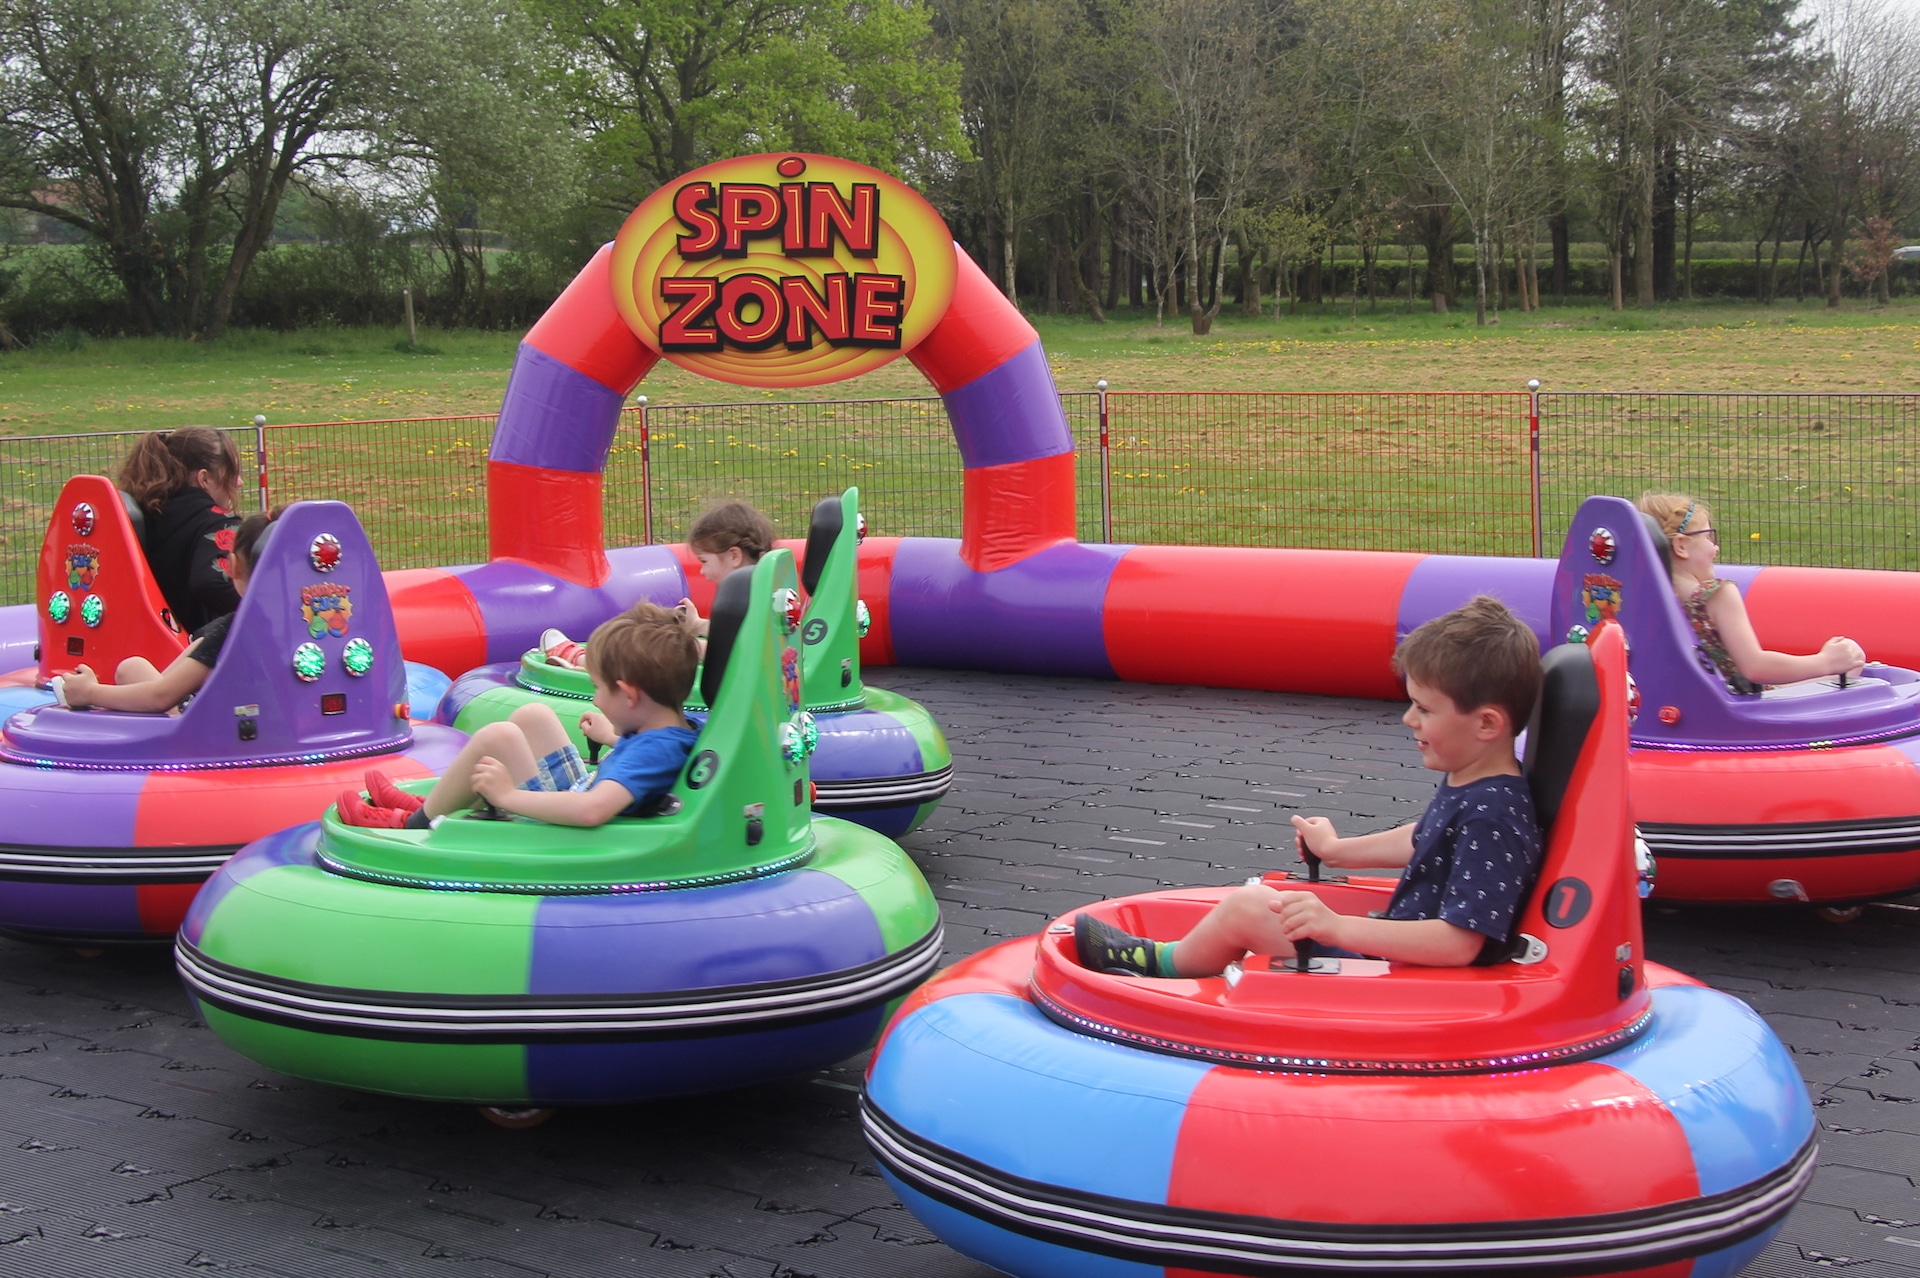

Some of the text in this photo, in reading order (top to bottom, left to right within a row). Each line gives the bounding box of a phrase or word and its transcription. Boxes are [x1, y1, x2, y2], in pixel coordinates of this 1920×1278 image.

[659, 272, 906, 353] ZONE
[805, 622, 824, 641] 5
[690, 756, 713, 783] 6
[1557, 885, 1577, 920] 1
